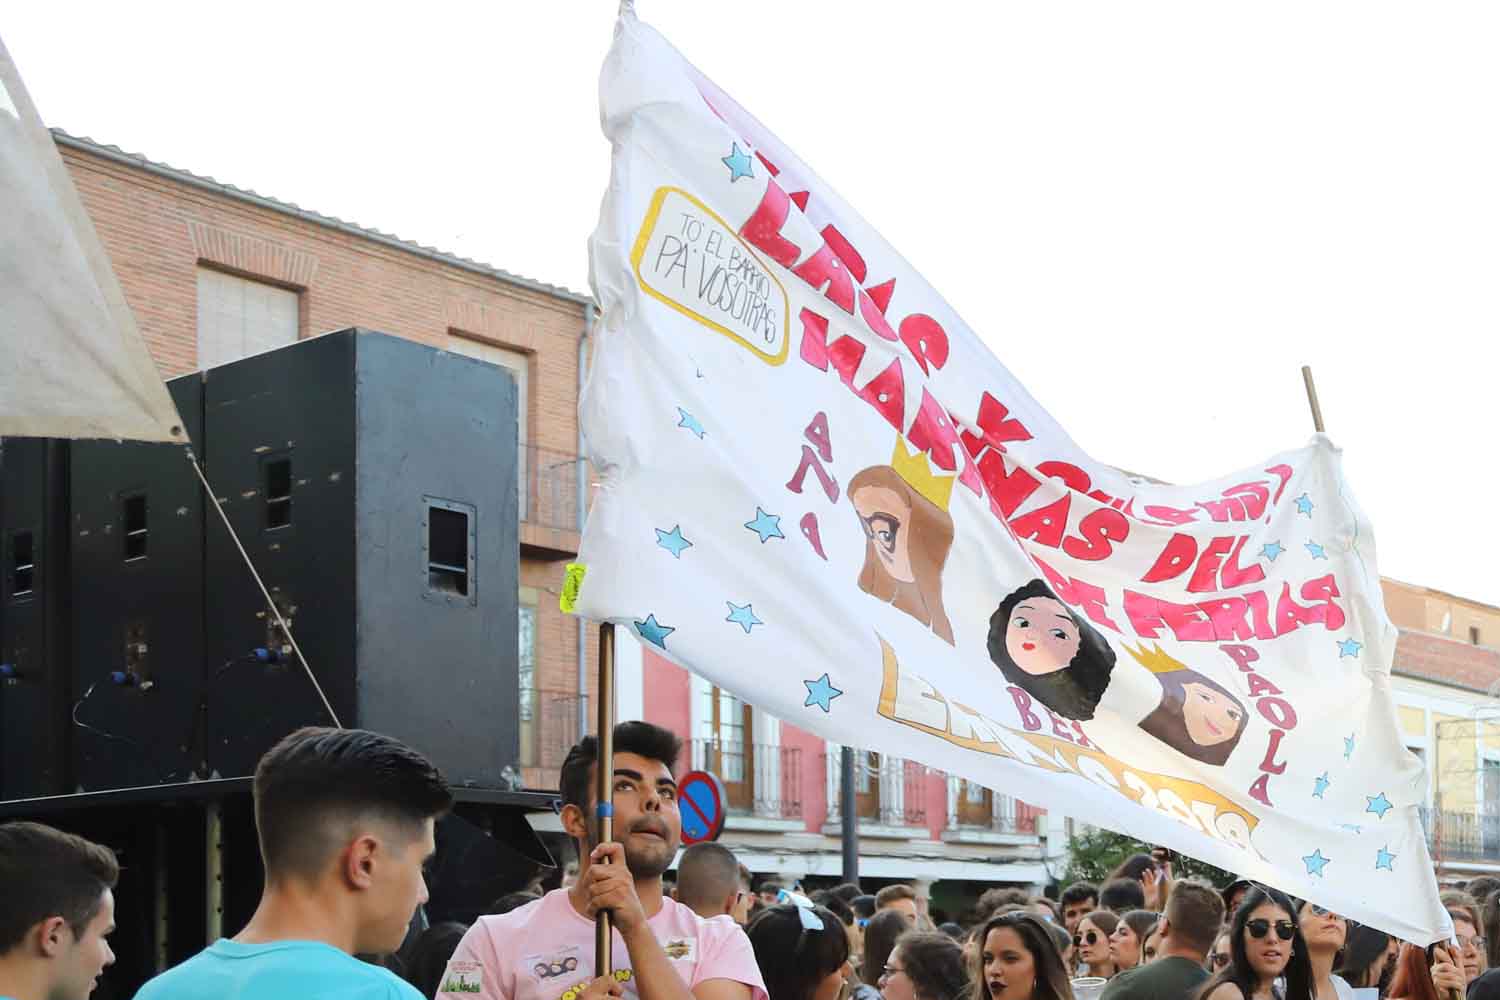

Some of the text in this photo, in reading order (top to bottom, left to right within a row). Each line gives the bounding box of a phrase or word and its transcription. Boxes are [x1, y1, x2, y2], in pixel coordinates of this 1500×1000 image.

[704, 230, 725, 260] EL
[697, 253, 777, 345] VOSOTRAS
[1140, 532, 1265, 594] DEL
[1122, 573, 1346, 643] FERIAS
[1219, 643, 1300, 808] PAOLA
